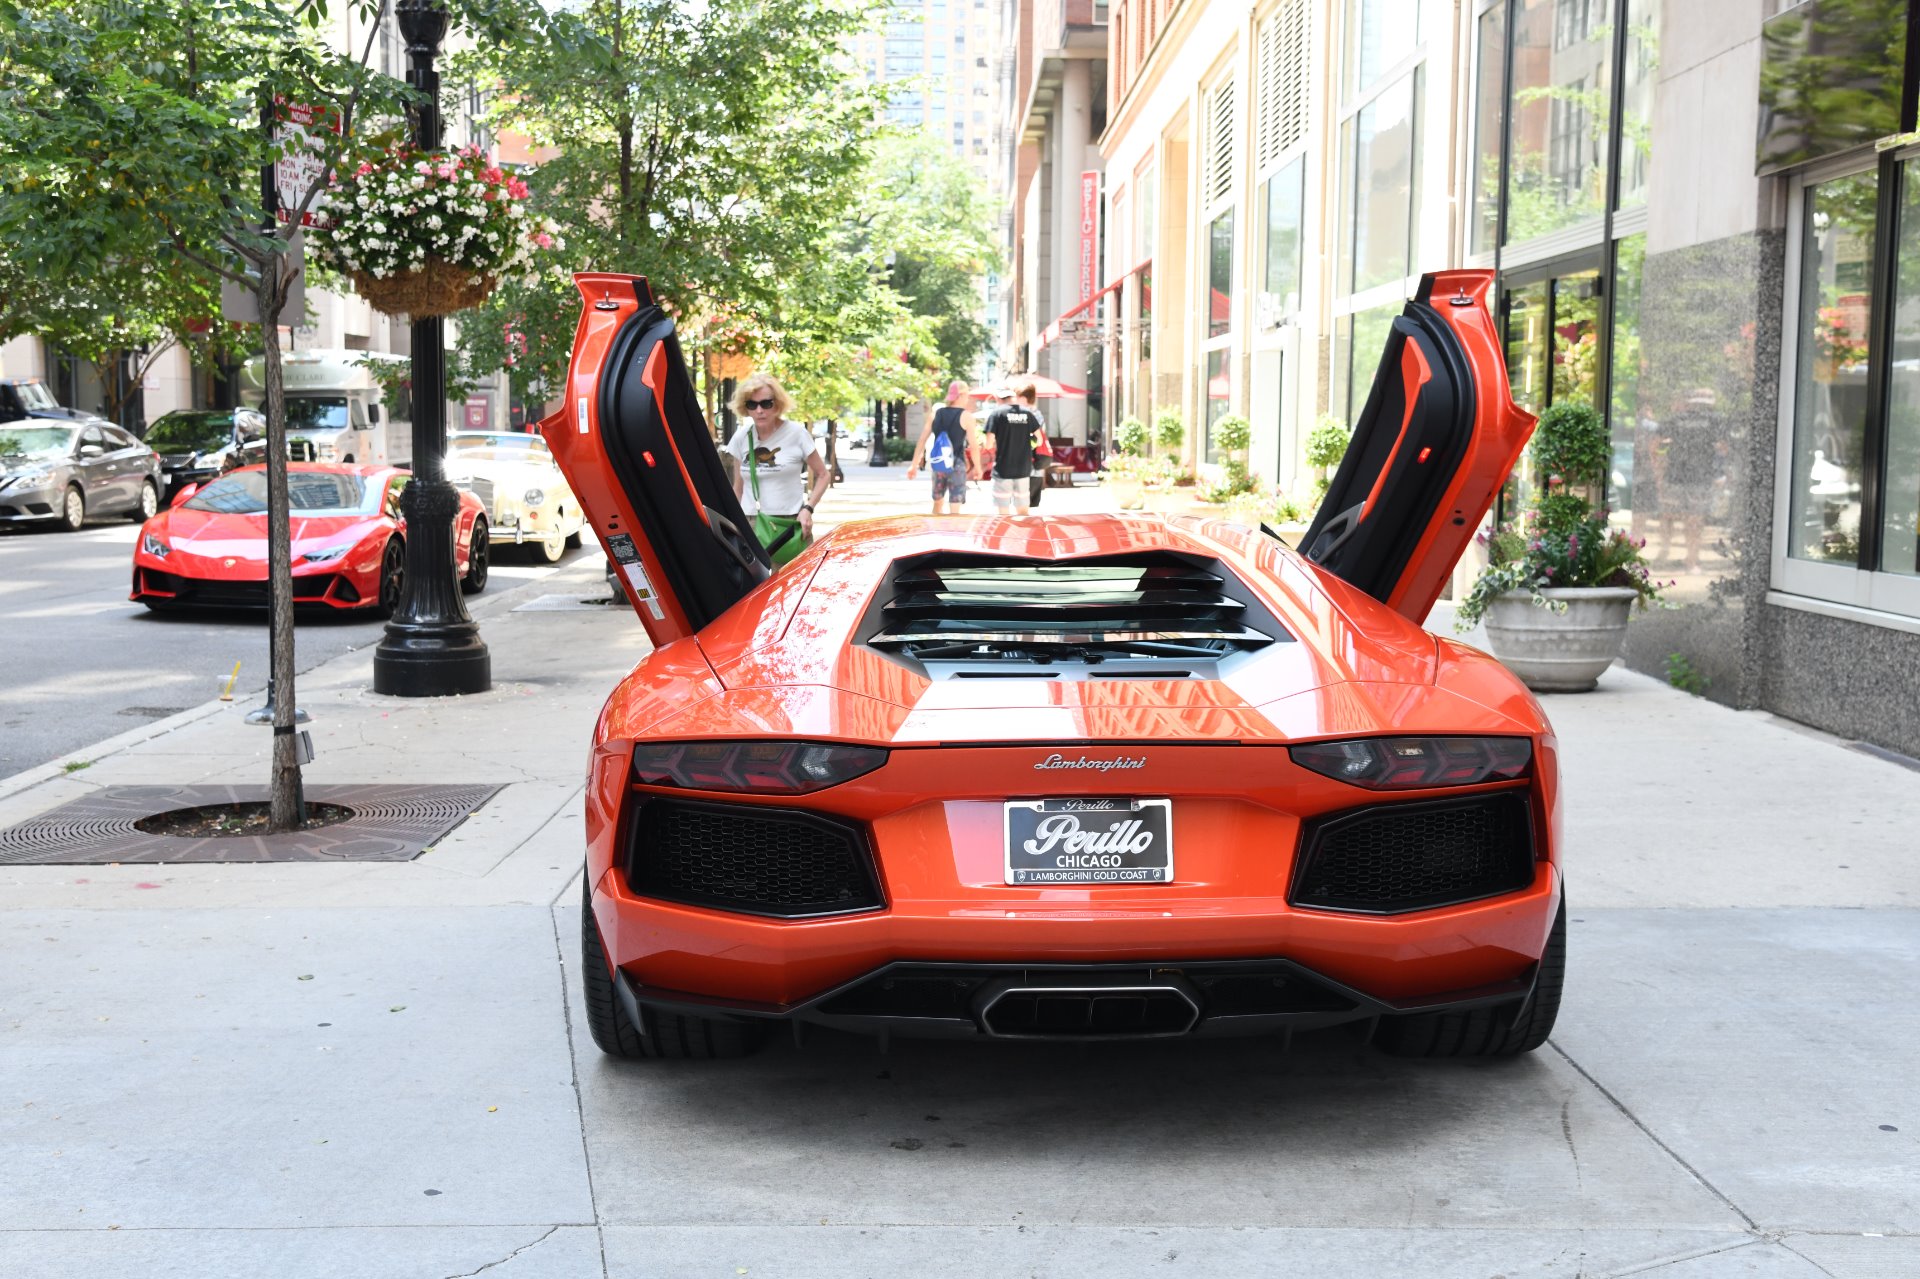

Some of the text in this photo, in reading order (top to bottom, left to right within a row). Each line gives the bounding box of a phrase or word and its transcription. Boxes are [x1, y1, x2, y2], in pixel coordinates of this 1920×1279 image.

[280, 159, 296, 169] MON
[280, 169, 287, 179] 10
[289, 170, 299, 181] AM
[280, 180, 293, 191] FRI
[1082, 178, 1093, 234] EPIC
[1033, 753, 1147, 773] Lamborghini
[1061, 799, 1114, 811] Perillo
[1023, 814, 1154, 855] Perillo
[1056, 855, 1122, 868] CHICAGO
[1030, 870, 1148, 881] LAMBORGHINI GOLD COAST
